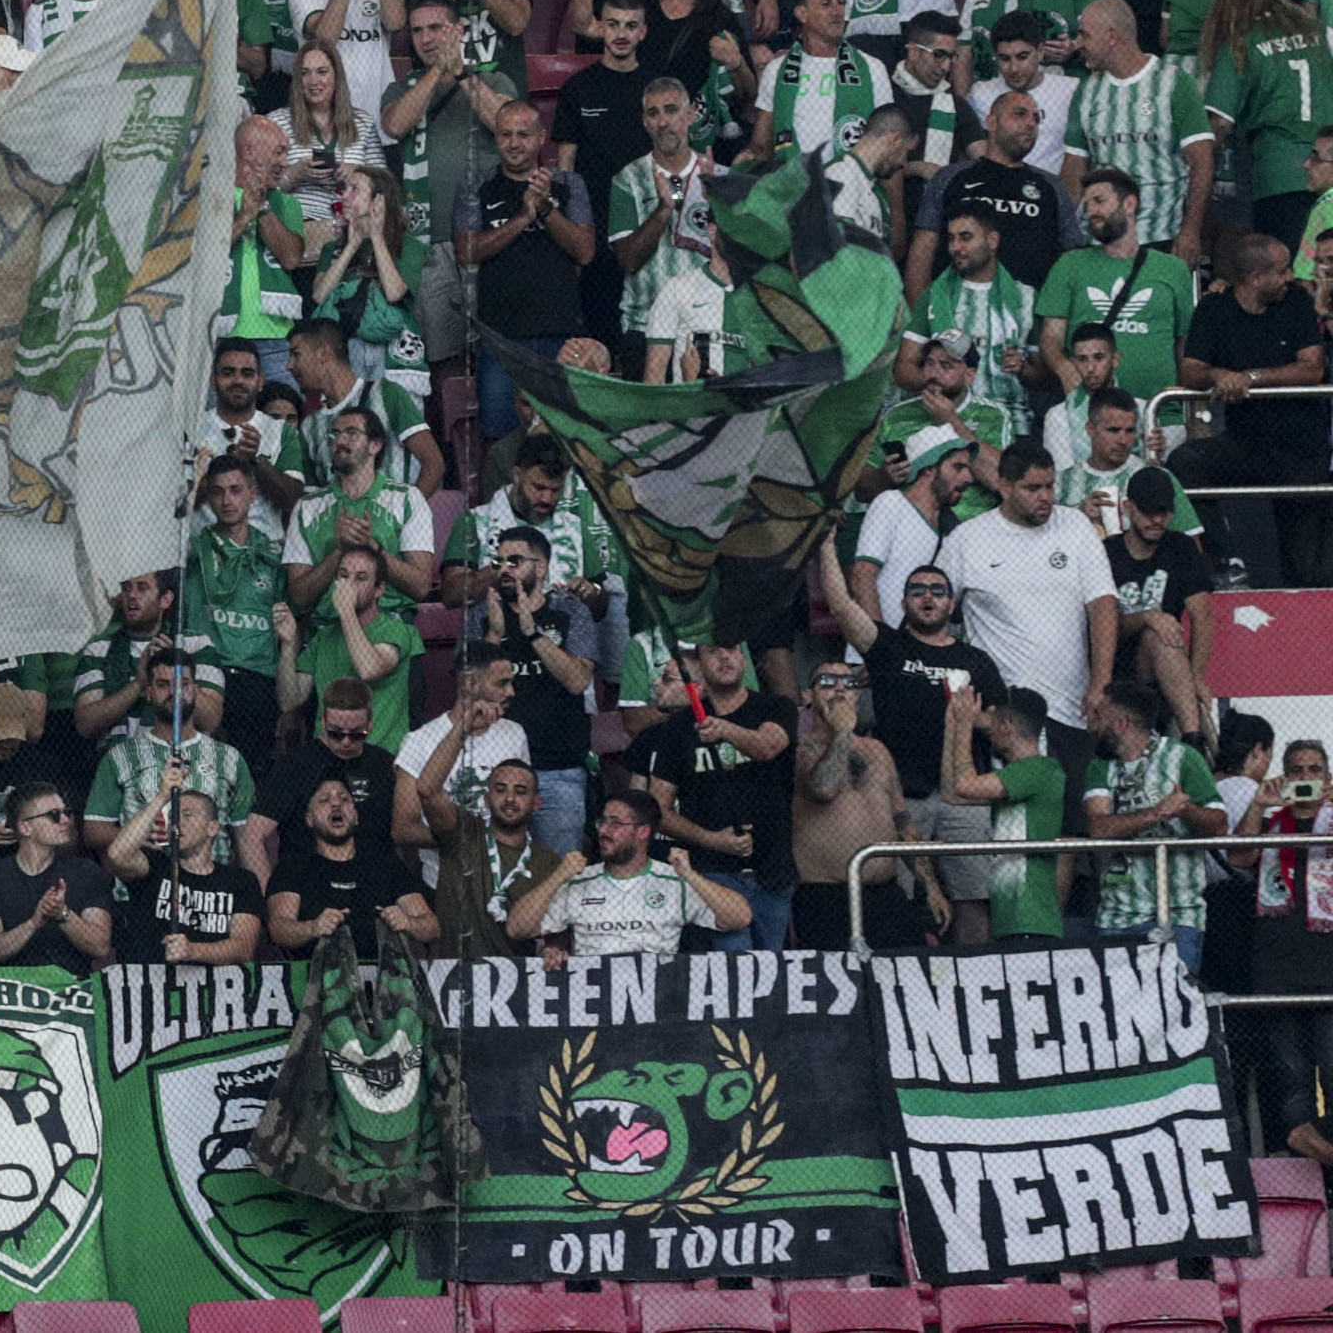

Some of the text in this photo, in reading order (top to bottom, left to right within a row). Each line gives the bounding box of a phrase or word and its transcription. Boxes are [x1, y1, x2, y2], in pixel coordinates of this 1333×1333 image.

[586, 920, 658, 935] HONDA
[420, 949, 864, 1028] GREEN APES
[870, 943, 1210, 1084] INFERNO
[908, 1117, 1253, 1273] VERDE
[548, 1218, 794, 1275] ON TOUR
